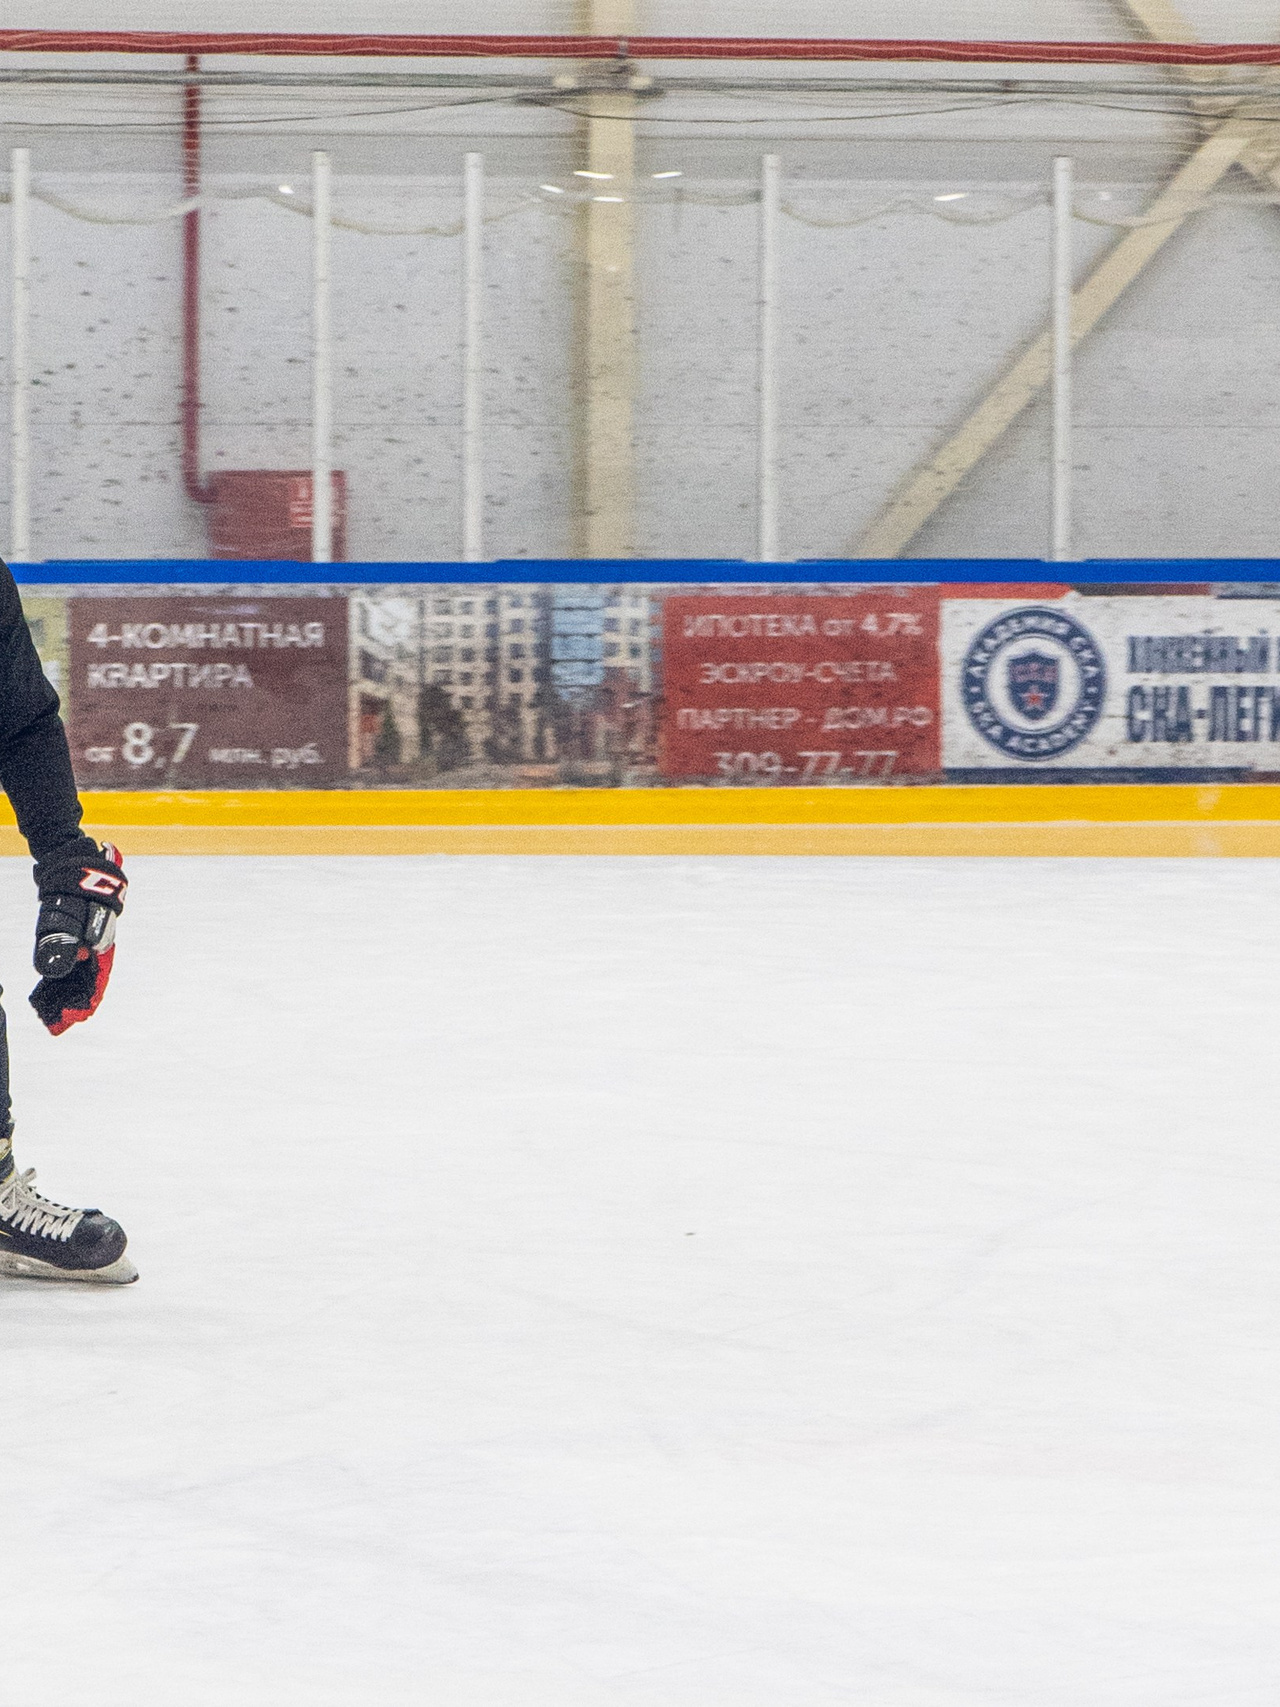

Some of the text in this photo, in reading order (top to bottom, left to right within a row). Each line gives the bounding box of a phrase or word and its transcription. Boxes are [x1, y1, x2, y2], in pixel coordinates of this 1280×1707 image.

[86, 621, 325, 649] 4-КОМНАТНАЯ
[684, 613, 818, 637] ИПОТЕКА
[86, 662, 254, 689] КВАРТИРА
[676, 707, 803, 731] ПАРТНЕР
[122, 720, 200, 769] 8,7
[712, 750, 900, 783] 309-77-77
